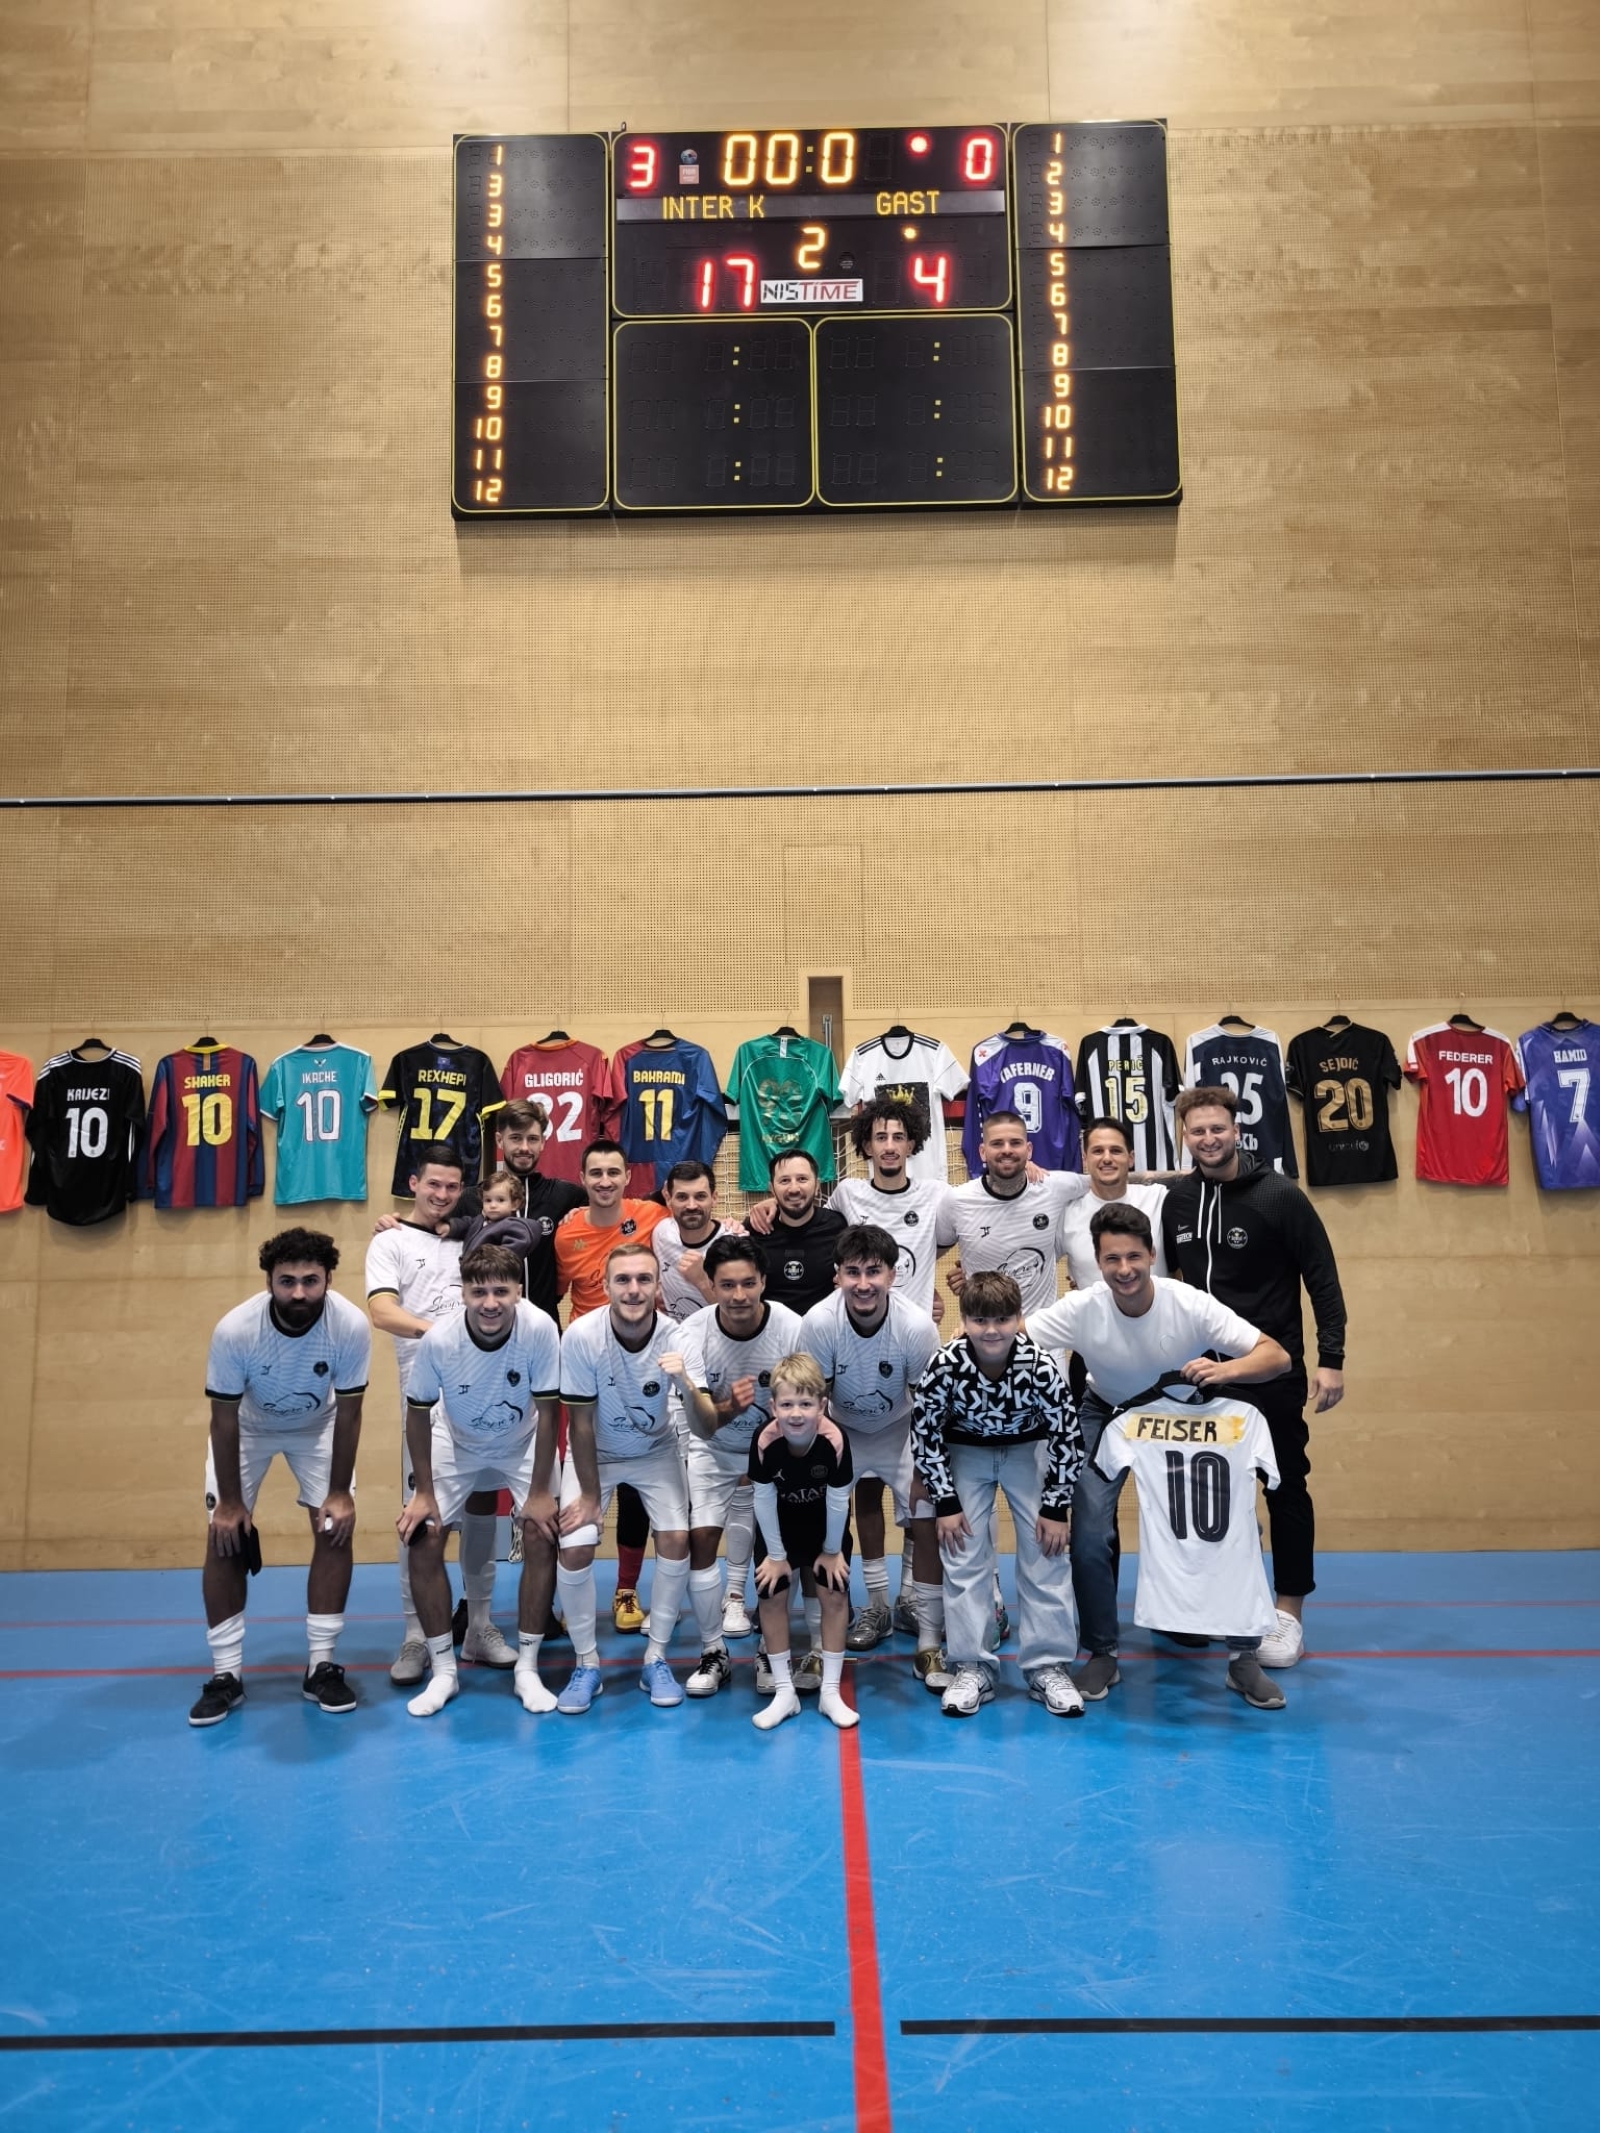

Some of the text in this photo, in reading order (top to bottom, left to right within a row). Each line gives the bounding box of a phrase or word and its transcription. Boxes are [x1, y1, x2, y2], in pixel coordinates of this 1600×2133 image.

[630, 145, 656, 188] 3
[963, 137, 994, 180] 0
[1046, 161, 1063, 185] 2
[488, 174, 503, 197] 3
[662, 194, 766, 220] INTER K
[875, 190, 940, 216] GAST
[1048, 191, 1064, 215] 3
[487, 204, 503, 227] 3
[1049, 222, 1065, 244] 4
[487, 235, 502, 256] 4
[797, 226, 826, 270] 2
[487, 264, 502, 287] 5
[1050, 252, 1066, 276] 5
[701, 257, 755, 308] 17
[913, 256, 947, 303] 4
[486, 294, 502, 318] 6
[1050, 282, 1066, 307] 6
[488, 325, 502, 346] 7
[1053, 313, 1068, 335] 7
[486, 355, 502, 378] 8
[1052, 343, 1069, 367] 8
[1054, 373, 1070, 398] 9
[486, 386, 502, 410] 9
[476, 417, 502, 440] 10
[1045, 404, 1071, 429] 10
[475, 449, 502, 470] 11
[1045, 436, 1072, 459] 11
[475, 479, 502, 502] 12
[1047, 466, 1074, 491] 12
[1211, 1055, 1268, 1067] RAJKOVIĆ
[1319, 1057, 1359, 1073] SEJDIĆ
[1438, 1050, 1494, 1066] FEDERER
[1553, 1048, 1588, 1064] HAMID
[417, 1068, 467, 1087] REXHEPI
[524, 1068, 584, 1088] GLIGORIĆ
[632, 1069, 686, 1086] BAHRAMI
[1104, 1075, 1149, 1124] 15
[1445, 1067, 1488, 1118] 10
[1557, 1067, 1591, 1123] 7
[296, 1089, 342, 1143] 10
[410, 1087, 467, 1141] 17
[638, 1088, 675, 1142] 11
[1013, 1082, 1043, 1134] 9
[1314, 1077, 1374, 1133] 20
[181, 1092, 233, 1147] 10
[65, 1107, 109, 1158] 10
[1136, 1416, 1218, 1443] FEISER
[1165, 1450, 1231, 1543] 10
